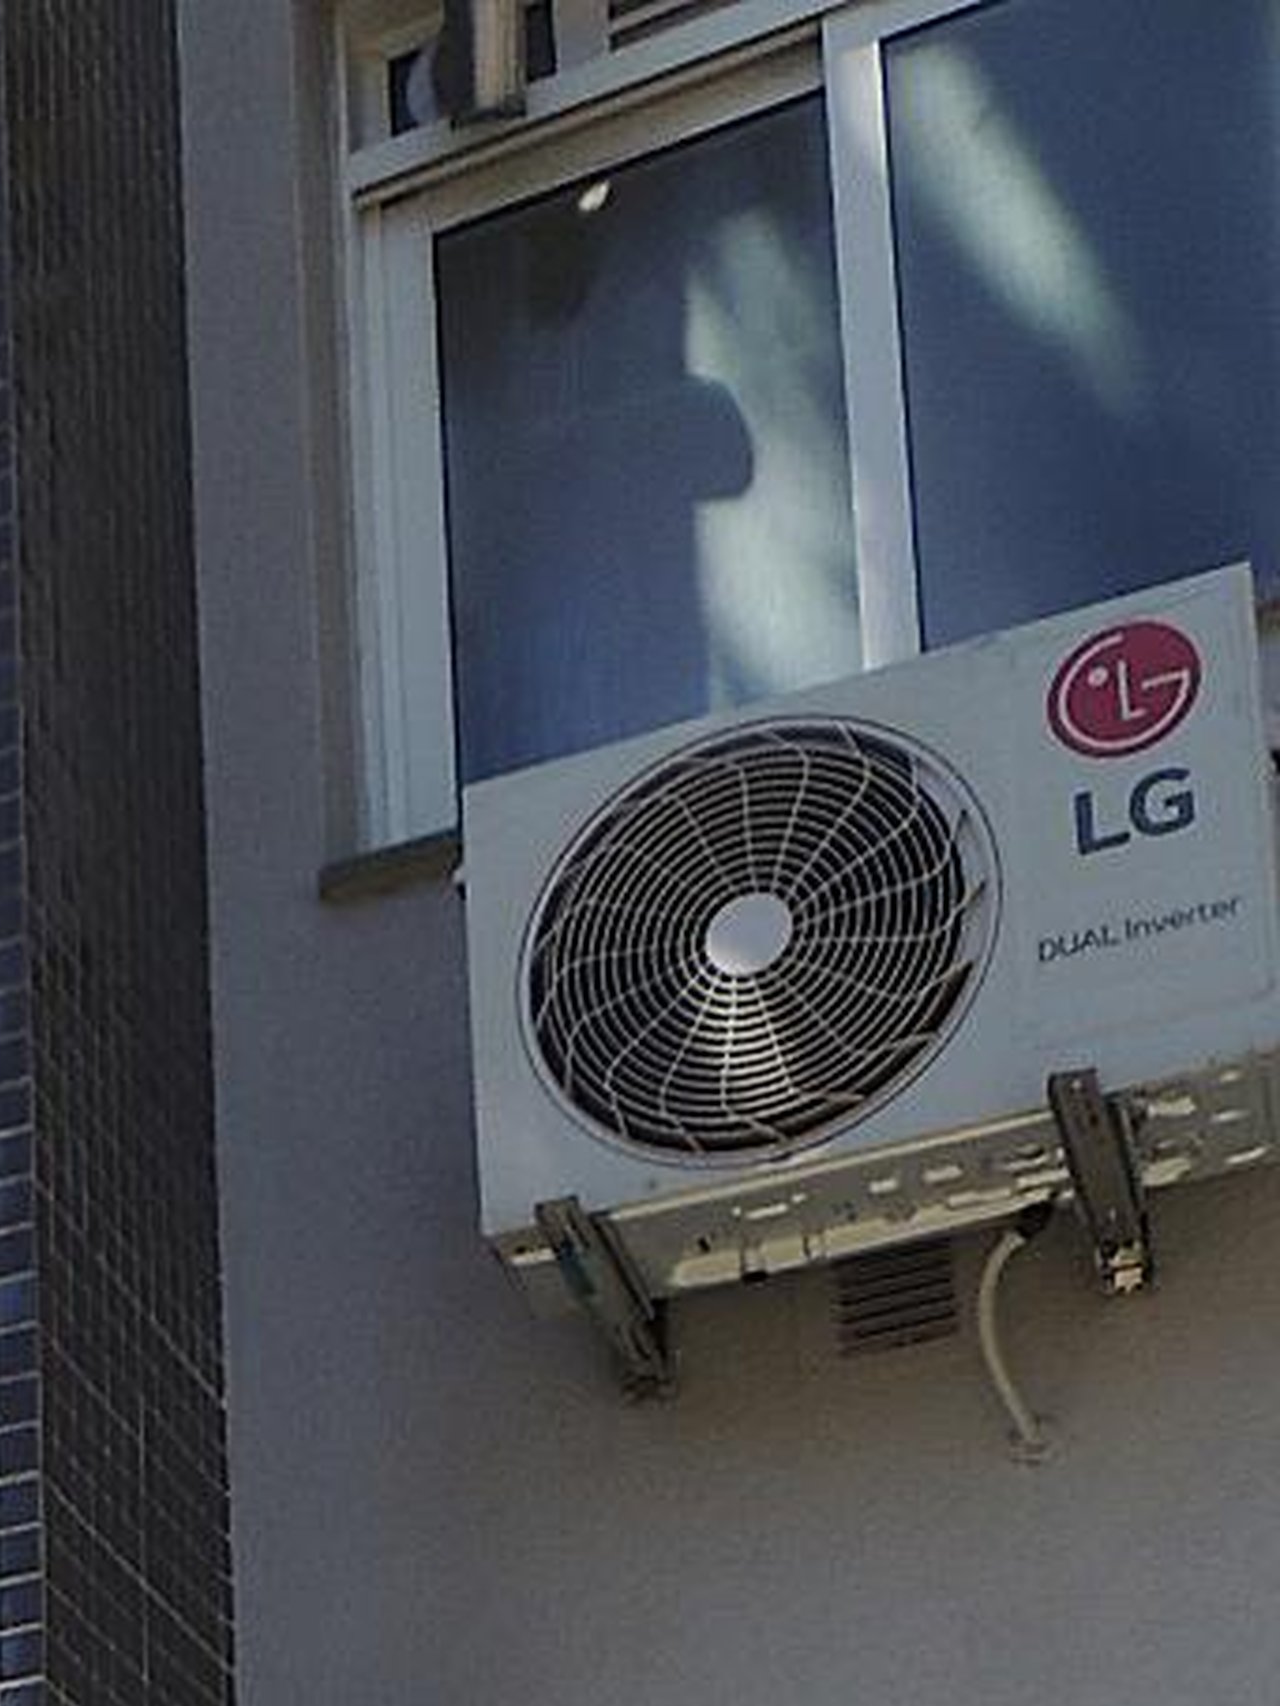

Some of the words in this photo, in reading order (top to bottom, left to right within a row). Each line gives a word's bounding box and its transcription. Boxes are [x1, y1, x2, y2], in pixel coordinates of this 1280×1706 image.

[1075, 768, 1195, 855] LG
[1039, 924, 1120, 961] DUAL
[1124, 897, 1238, 941] Inverter
